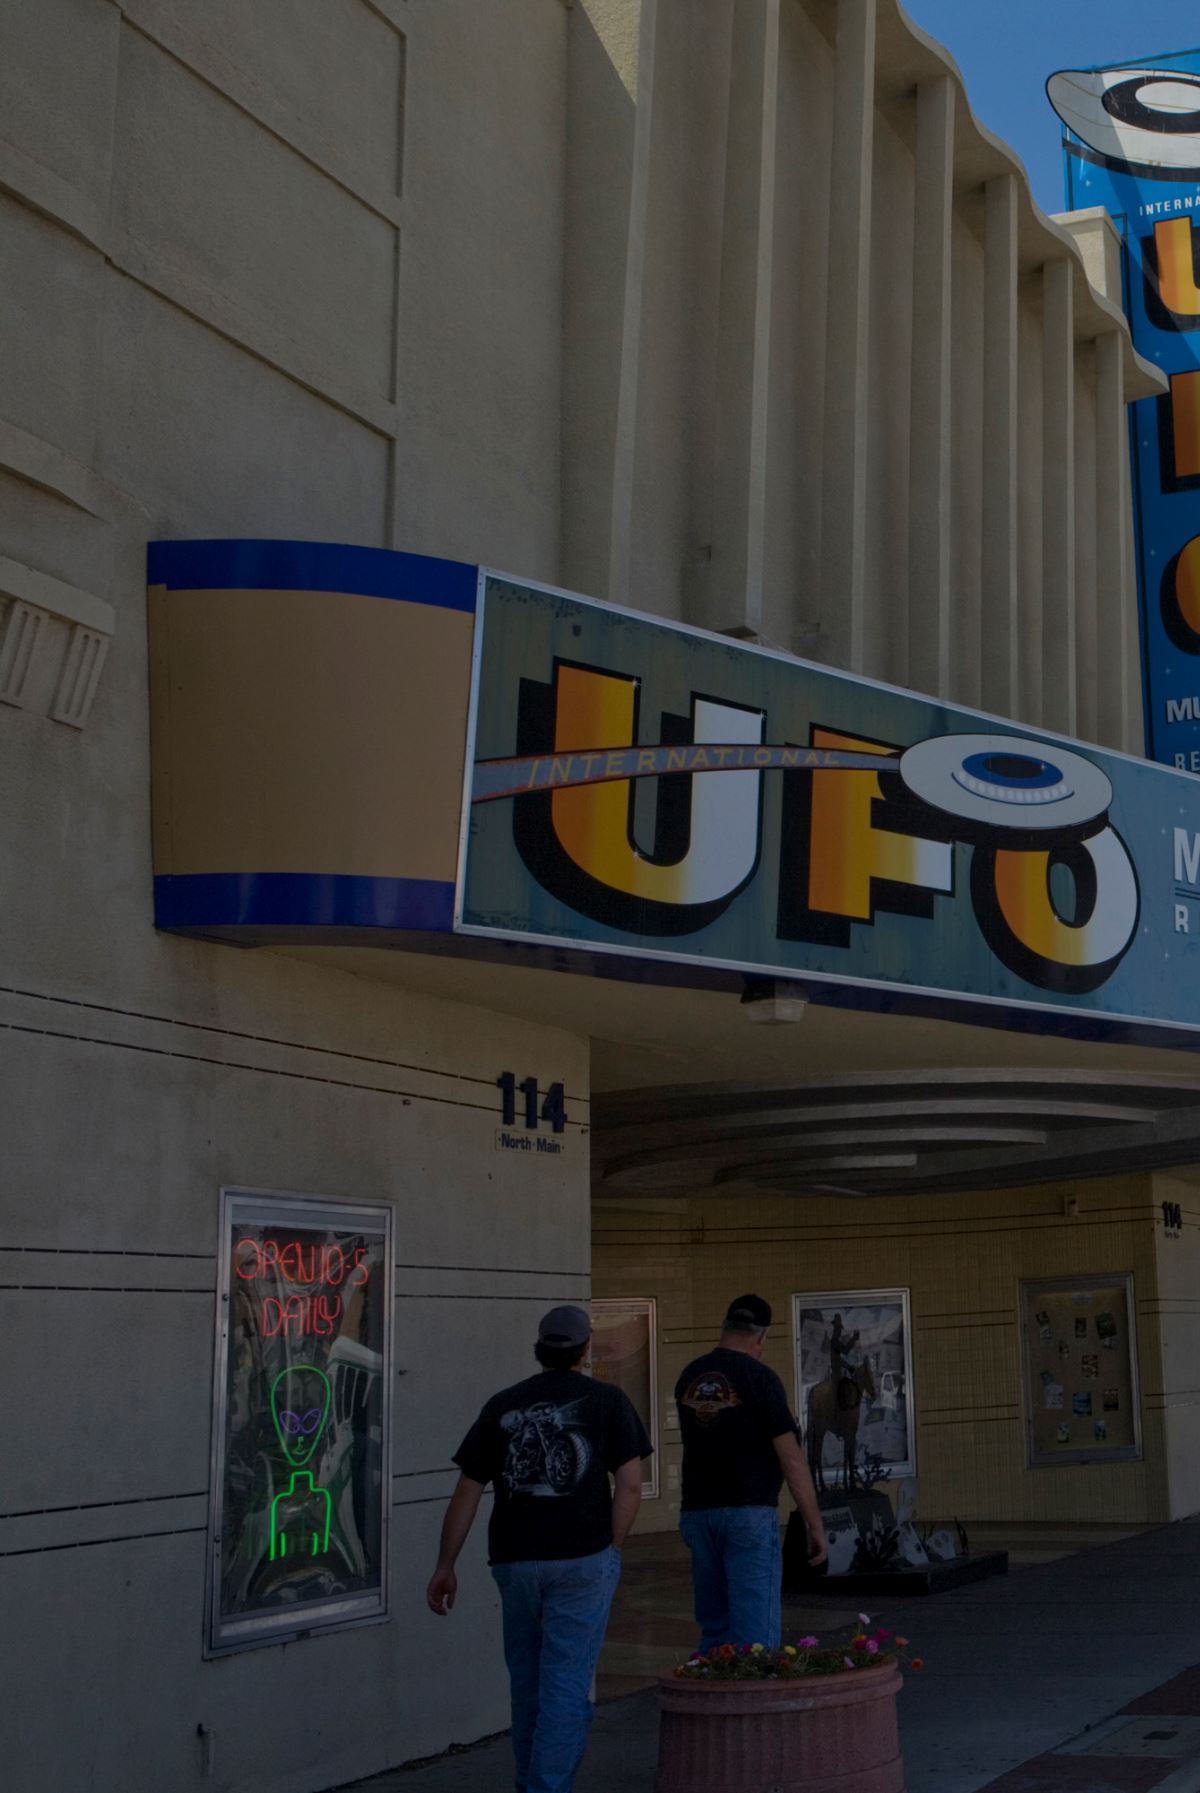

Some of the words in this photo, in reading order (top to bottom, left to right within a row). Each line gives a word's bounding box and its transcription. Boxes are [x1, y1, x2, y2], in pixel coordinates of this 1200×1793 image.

[527, 747, 841, 789] INTERNATIONAL
[530, 656, 1140, 988] UFO
[497, 1072, 568, 1133] 114
[501, 1133, 532, 1151] North
[537, 1138, 562, 1154] Main
[235, 1238, 315, 1283] OPEN
[262, 1295, 341, 1337] DAILY
